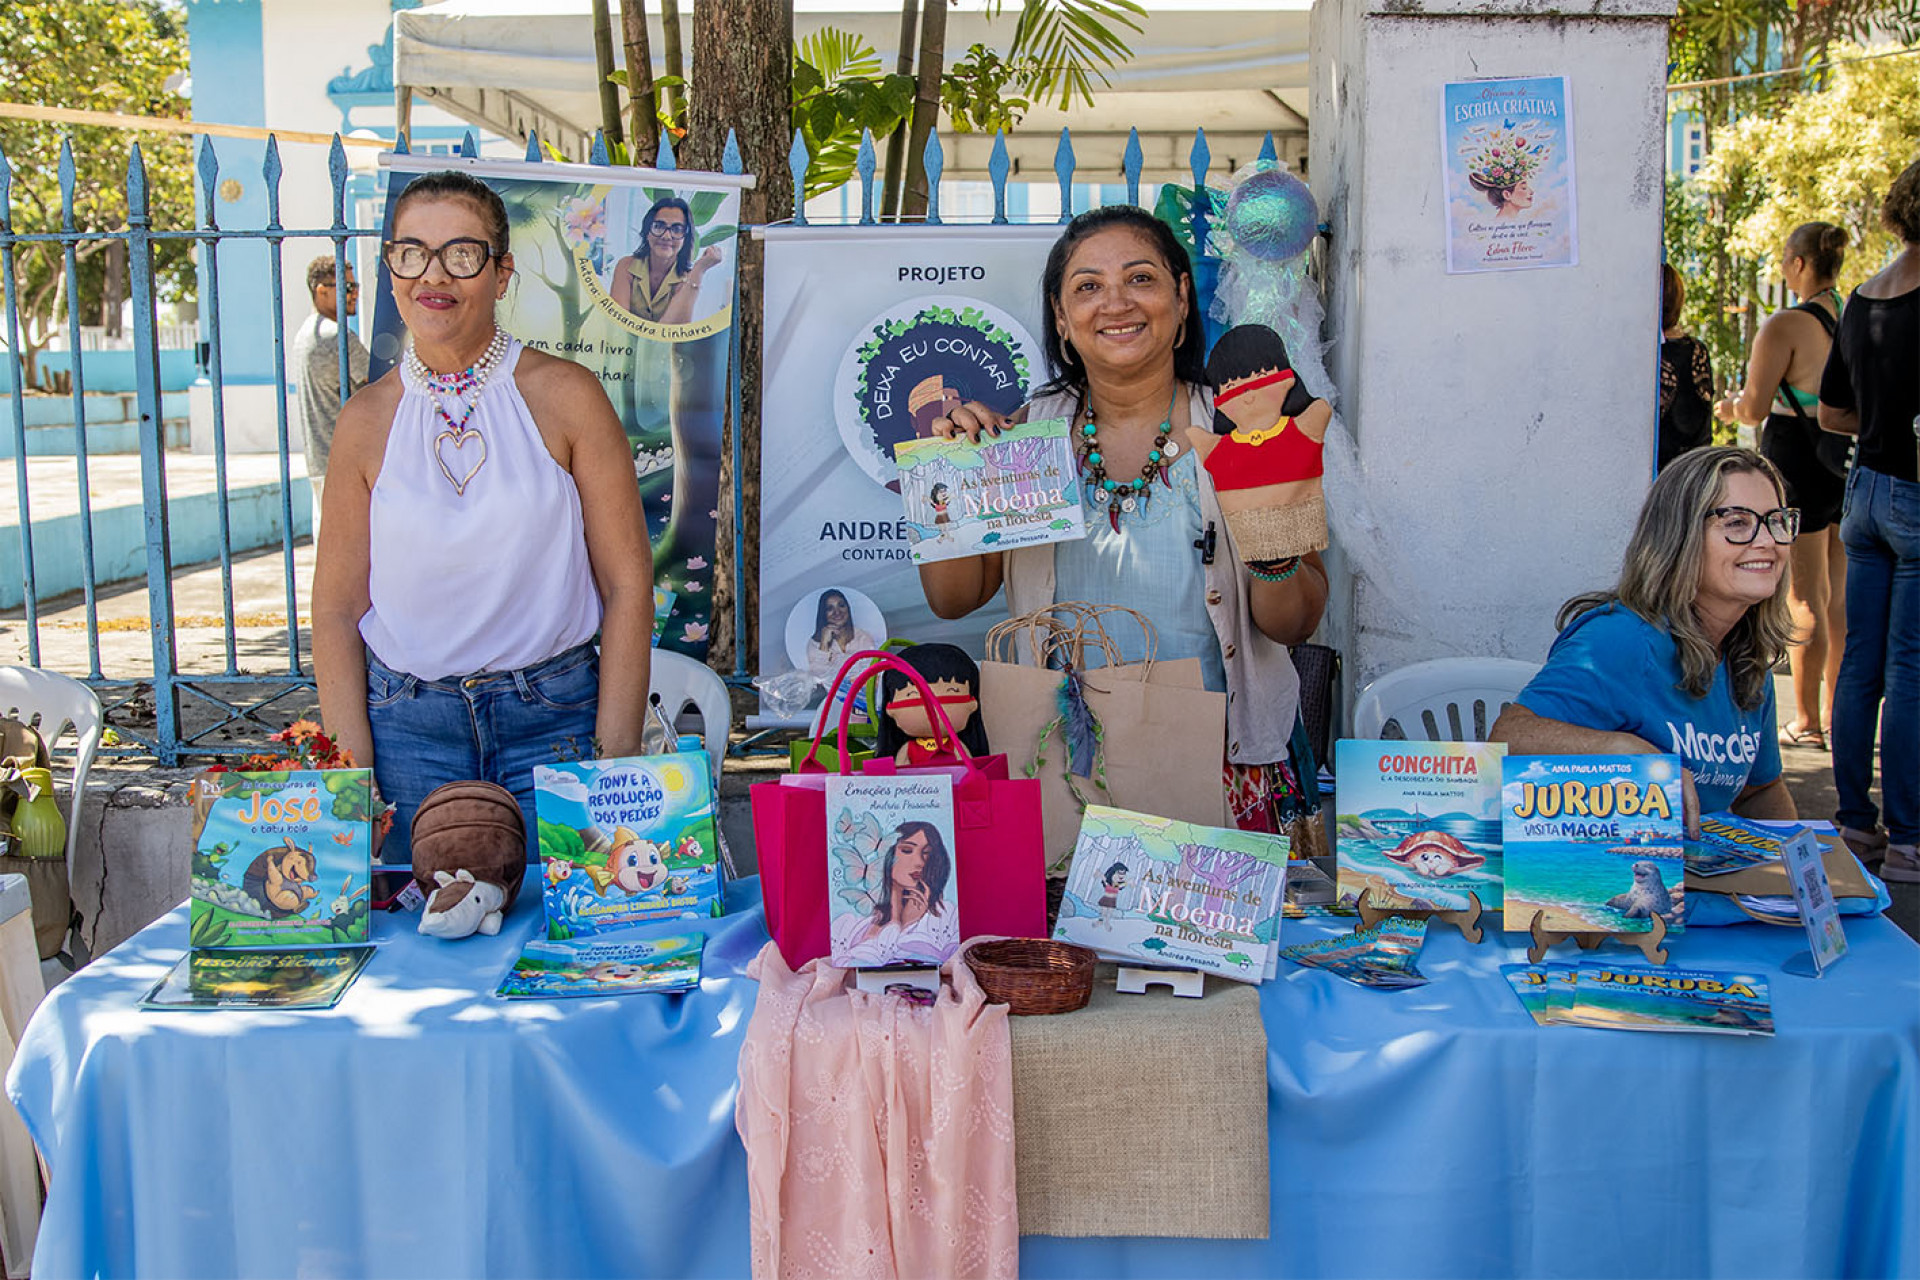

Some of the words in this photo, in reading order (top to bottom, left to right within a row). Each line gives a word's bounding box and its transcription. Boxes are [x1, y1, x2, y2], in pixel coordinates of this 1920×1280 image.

[1454, 101, 1500, 123] ESCRITA
[1503, 99, 1558, 117] CRIATIVA
[898, 266, 986, 285] PROJETO
[579, 258, 601, 298] Autora:
[600, 298, 657, 335] Alessandra
[555, 338, 593, 353] cada
[600, 340, 633, 355] livro
[874, 365, 900, 420] DEIXA
[899, 340, 928, 364] EU
[961, 478, 978, 490] As
[981, 469, 1040, 487] aventuras
[1045, 465, 1060, 478] de
[963, 488, 1063, 517] Moema
[820, 516, 908, 541] ANDRÉ
[987, 519, 1003, 530] na
[1004, 511, 1053, 527] floresta
[1378, 754, 1478, 774] CONCHITA
[1552, 765, 1570, 773] ANA
[1571, 764, 1598, 774] PAULA
[1599, 764, 1632, 773] MATTOS
[599, 773, 628, 791] TONY
[630, 773, 638, 787] E
[641, 774, 650, 786] A
[844, 782, 891, 797] Emoções
[894, 783, 940, 798] poéticas
[237, 788, 322, 824] José
[589, 787, 663, 807] REVOLUÇÃO
[1513, 780, 1672, 820] JURUBA
[594, 809, 617, 824] DOS
[620, 805, 660, 823] PEIXES
[251, 826, 257, 834] o
[261, 825, 284, 834] tatu
[1524, 822, 1559, 837] VISITA
[1561, 820, 1621, 838] MACAÉ
[1142, 868, 1163, 884] As
[1167, 877, 1238, 902] aventuras
[1242, 890, 1261, 906] de
[1135, 885, 1255, 937] Moema
[1154, 924, 1173, 938] na
[1178, 925, 1234, 950] floresta
[194, 957, 273, 968] TESOURO
[276, 957, 351, 968] SECRETO
[1186, 954, 1220, 968] Pessanha
[1590, 971, 1758, 998] JURUBA
